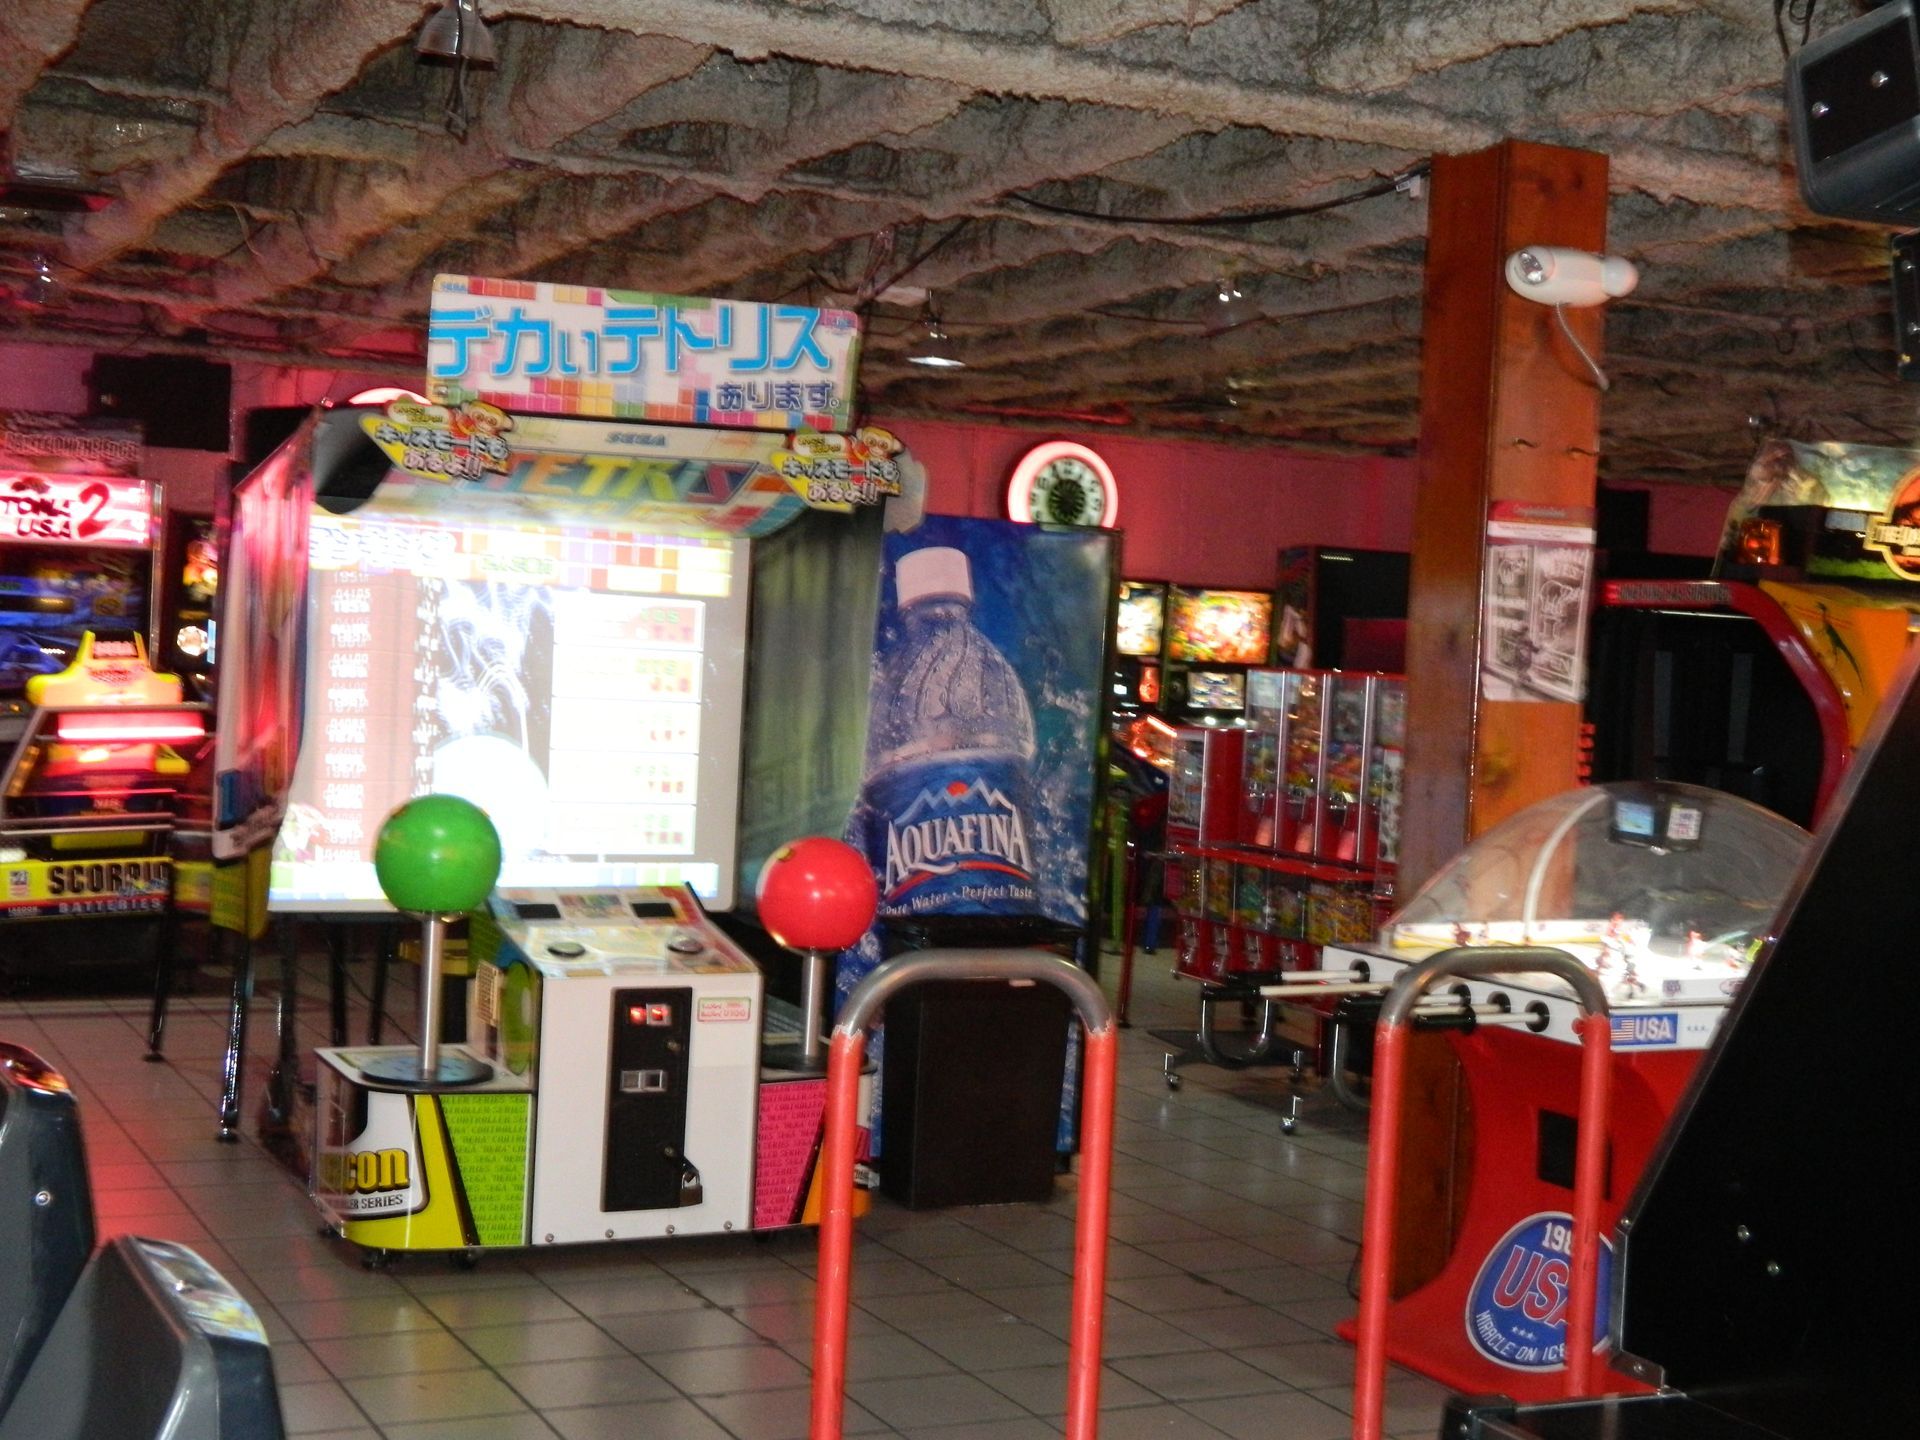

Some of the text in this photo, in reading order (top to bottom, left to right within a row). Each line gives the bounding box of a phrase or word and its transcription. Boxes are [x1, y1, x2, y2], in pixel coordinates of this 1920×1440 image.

[430, 304, 831, 378] デカいテトリス
[716, 380, 840, 411] あります。
[883, 804, 1033, 895] AQUAFINA
[58, 898, 162, 914] BATTERIES
[911, 892, 947, 909] Water
[961, 885, 1004, 904] Perfect
[1007, 884, 1033, 898] Taste
[1635, 1016, 1672, 1040] USA
[361, 1194, 403, 1210] SERIES
[1476, 1310, 1516, 1356] MIRACLE
[1515, 1345, 1535, 1361] ON
